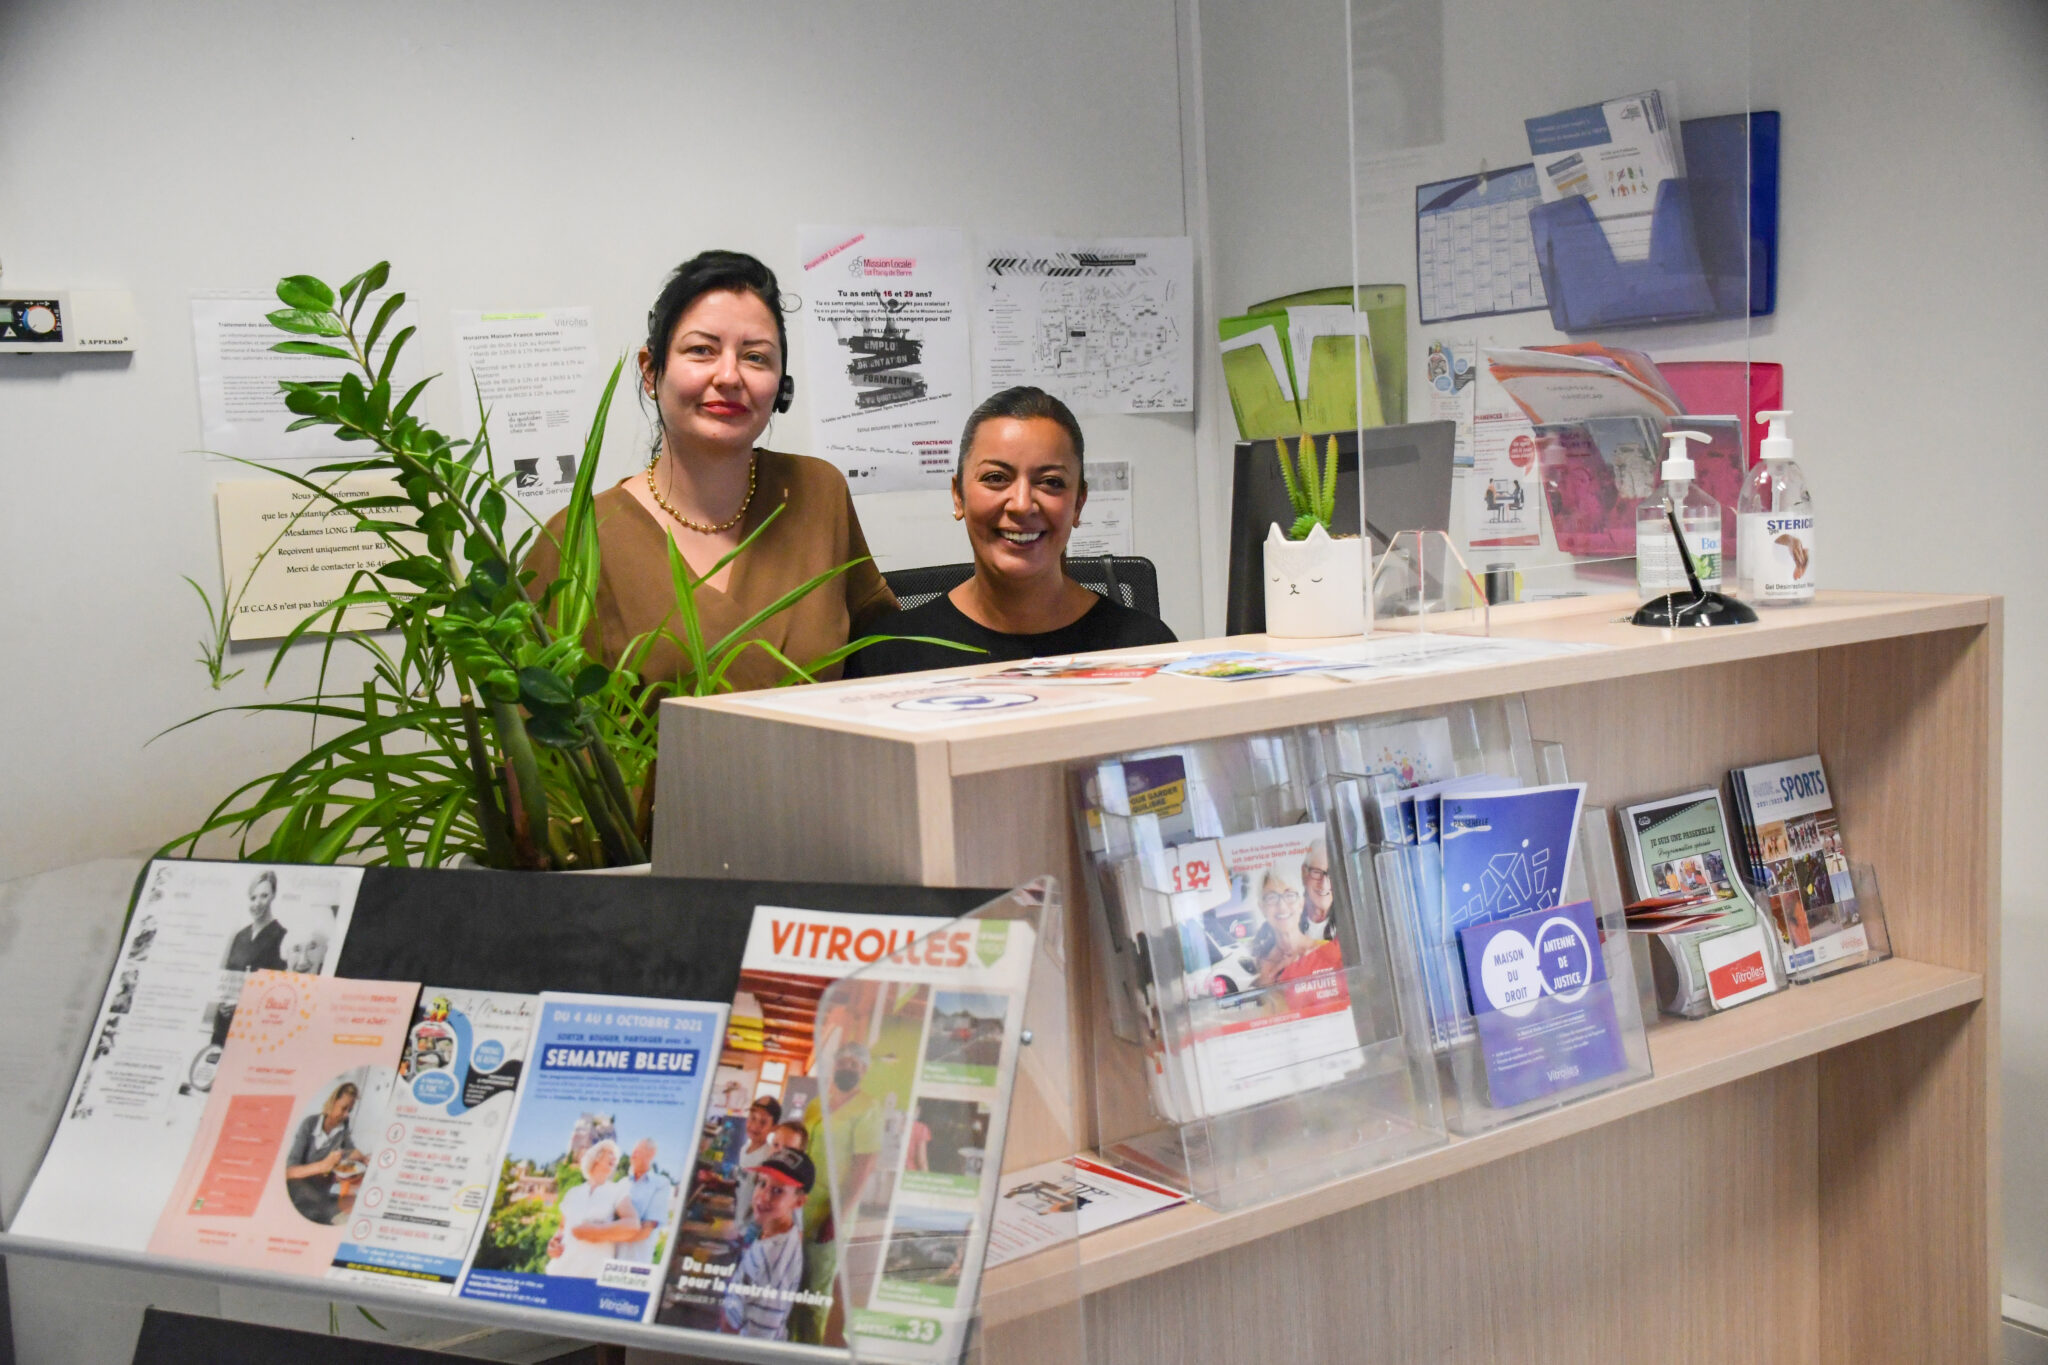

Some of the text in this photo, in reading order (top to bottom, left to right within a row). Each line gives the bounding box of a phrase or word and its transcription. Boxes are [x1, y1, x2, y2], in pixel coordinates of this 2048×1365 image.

[863, 259, 912, 269] Mission Locale
[857, 355, 908, 370] ORENTATON
[863, 373, 912, 386] FORMATION
[292, 492, 312, 500] Nous
[517, 489, 543, 498] France
[261, 513, 276, 521] que
[277, 511, 288, 519] les
[285, 529, 324, 537] Mesdames
[278, 548, 314, 556] Reçoivent
[315, 544, 360, 553] uniquement
[286, 566, 309, 574] Merci
[320, 563, 355, 571] contacter
[356, 561, 364, 569] le
[279, 602, 297, 611] n'est
[299, 601, 312, 611] pas
[1780, 770, 1825, 803] SPORTS
[1650, 825, 1716, 849] JE SUIS UNE PASSERELLE
[772, 919, 972, 969] VITROLLES
[1493, 934, 1576, 967] MAISON ANTENNE
[1507, 955, 1568, 983] DU DE
[1732, 965, 1766, 985] Vitrolles
[1294, 975, 1338, 994] GRATUITE
[1504, 971, 1582, 1003] DROIT JUSTICE
[554, 1010, 570, 1022] DU
[574, 1012, 581, 1023] 4
[585, 1012, 601, 1025] AU
[616, 1014, 671, 1029] OCTOBRE
[674, 1018, 703, 1032] 2021
[545, 1048, 694, 1071] SEMAINE BLEUE
[1546, 1065, 1579, 1081] Vitrolles
[604, 1263, 628, 1276] pass
[682, 1256, 737, 1277] Du neuf
[601, 1273, 648, 1287] sanitaire
[678, 1275, 834, 1306] pour la rentrée scolaire
[599, 1297, 641, 1316] Vitrolles
[906, 1319, 936, 1342] 33
